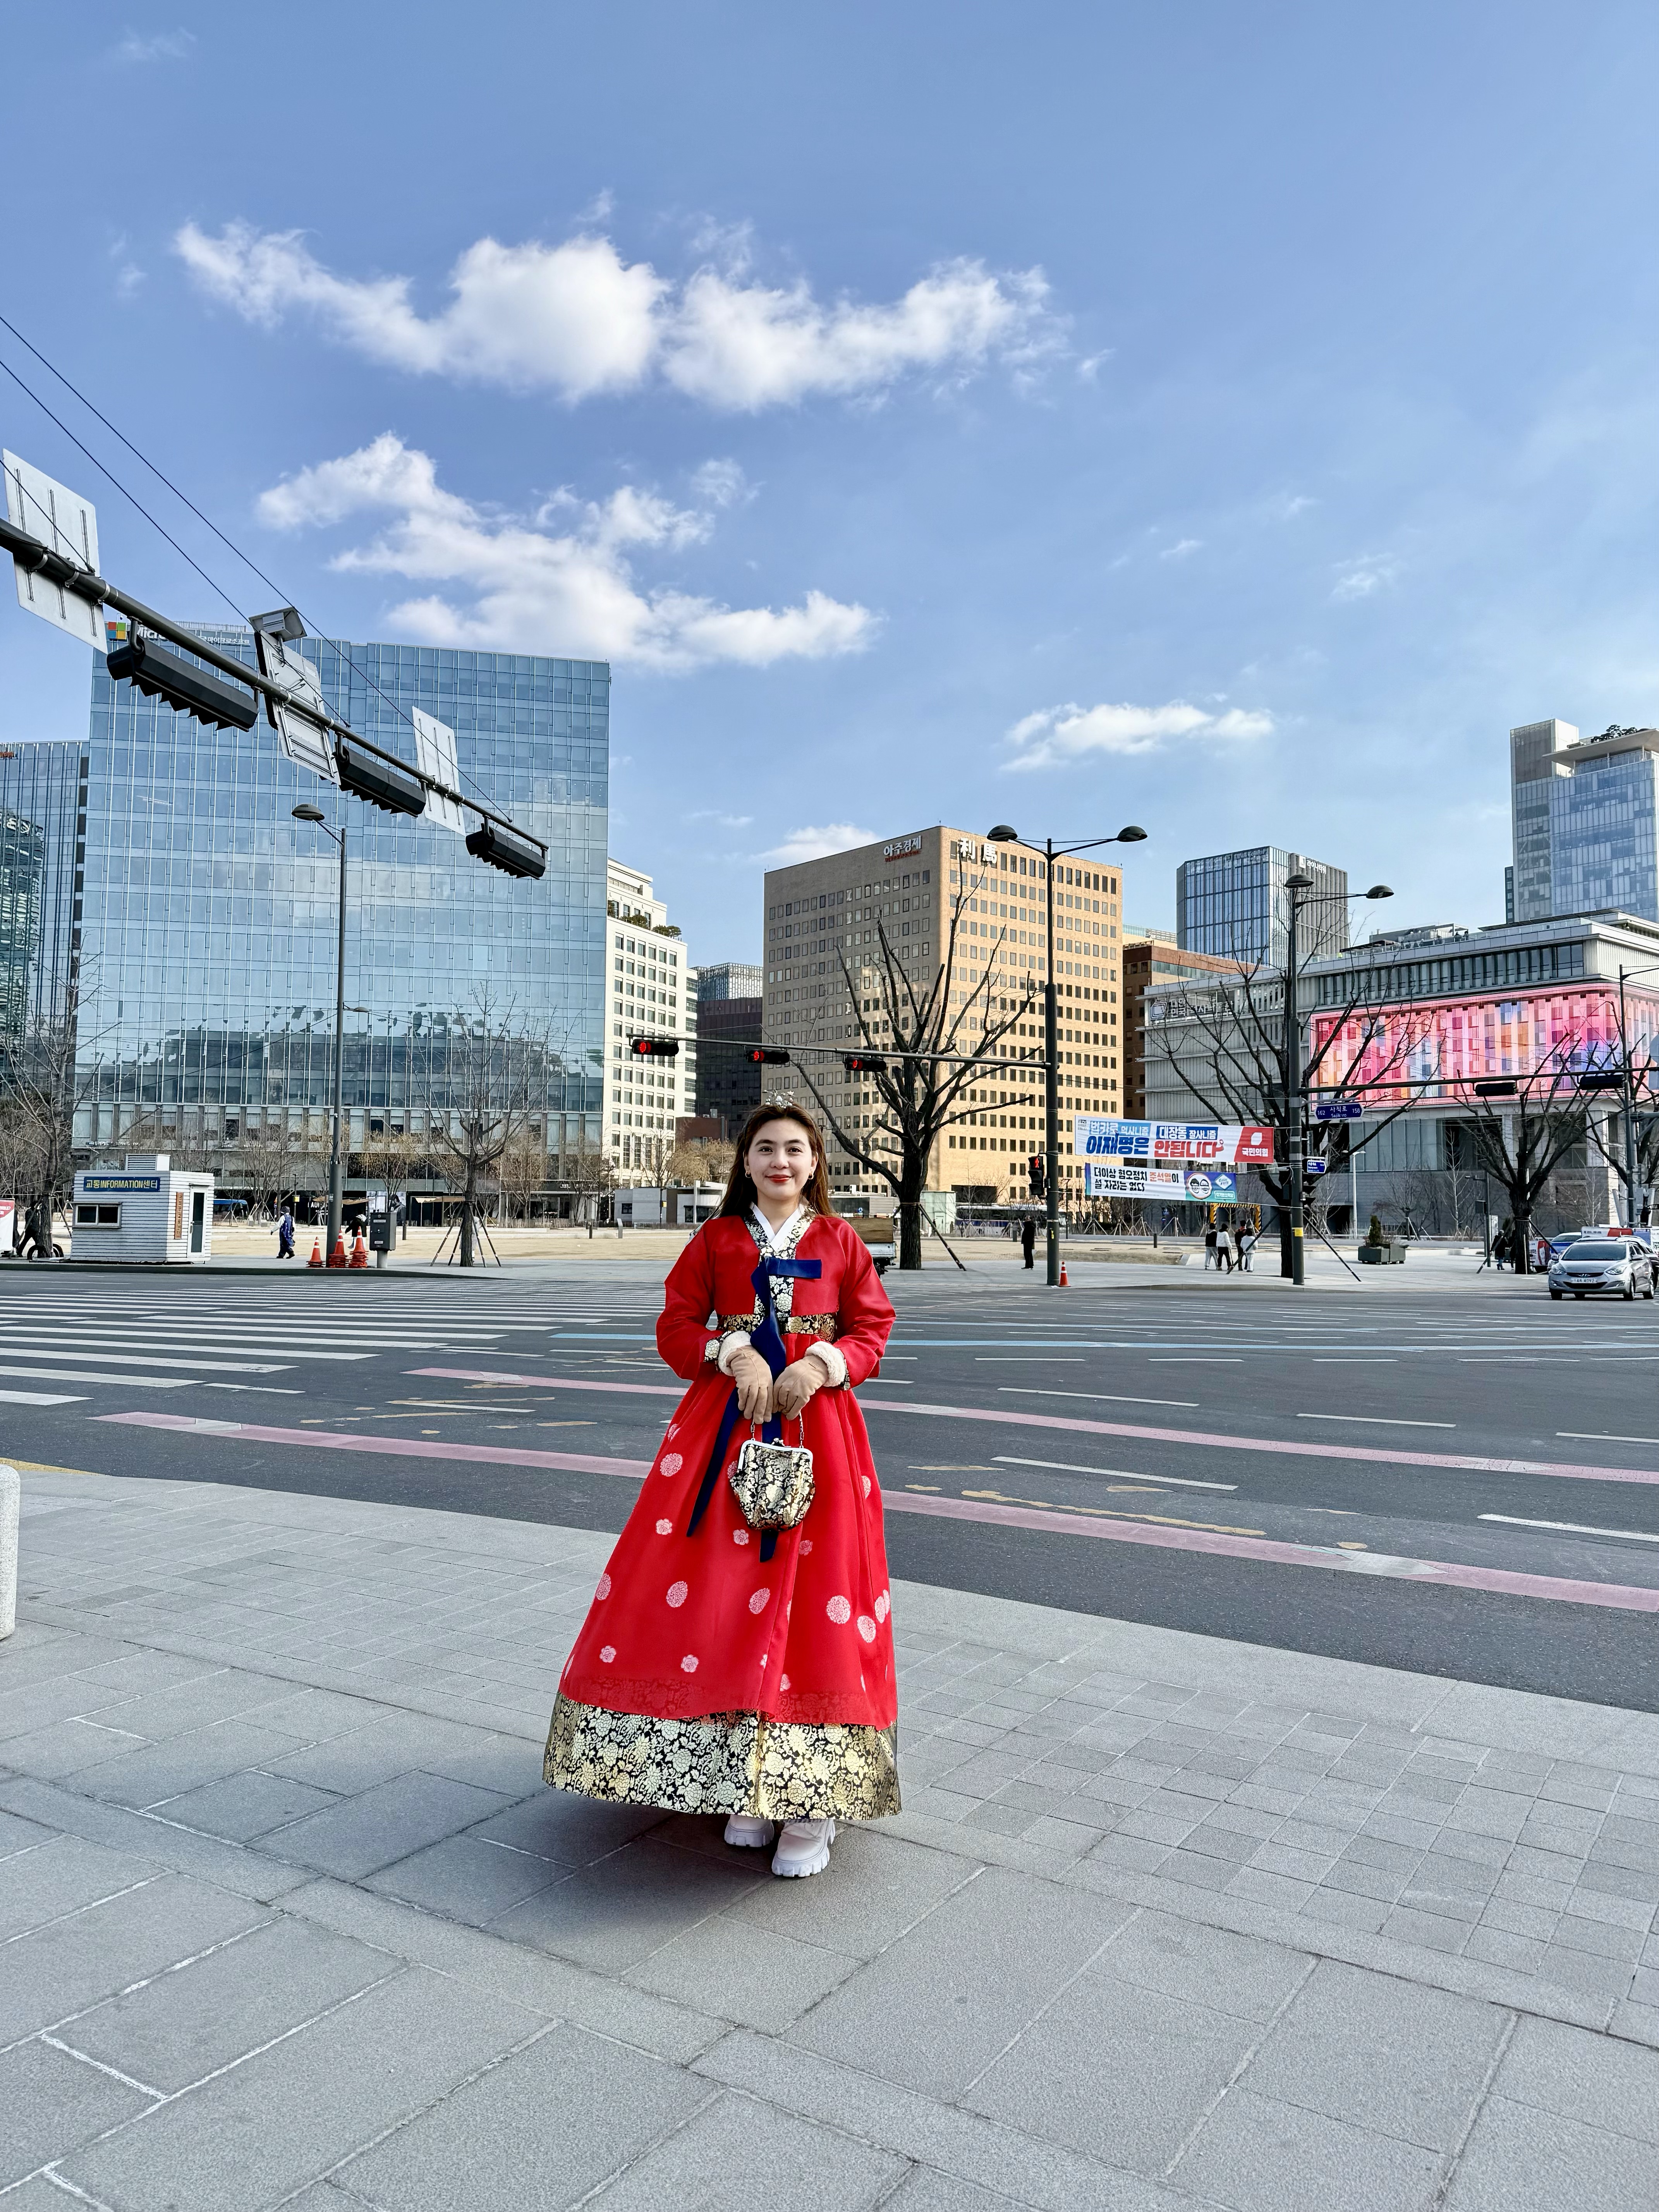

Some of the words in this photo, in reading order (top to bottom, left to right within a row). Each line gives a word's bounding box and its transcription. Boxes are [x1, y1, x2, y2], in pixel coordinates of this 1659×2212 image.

[883, 835, 921, 856] 아주경제
[1091, 1121, 1118, 1135] 법카로
[1159, 1127, 1187, 1139] 대장동
[1189, 1130, 1216, 1139] 잘사니즘
[1086, 1135, 1149, 1154] 이재명은
[1154, 1140, 1224, 1158] 안됩니다
[1242, 1147, 1268, 1157] 국민의힘
[1094, 1167, 1116, 1178] 더이상
[1118, 1169, 1147, 1181] 혐오정치
[1150, 1172, 1179, 1183] 준석열이
[86, 1180, 158, 1189] 교통INFORMATION센터
[1095, 1179, 1102, 1189] 설
[1104, 1180, 1127, 1190] 자리는
[1129, 1182, 1145, 1192] 없다
